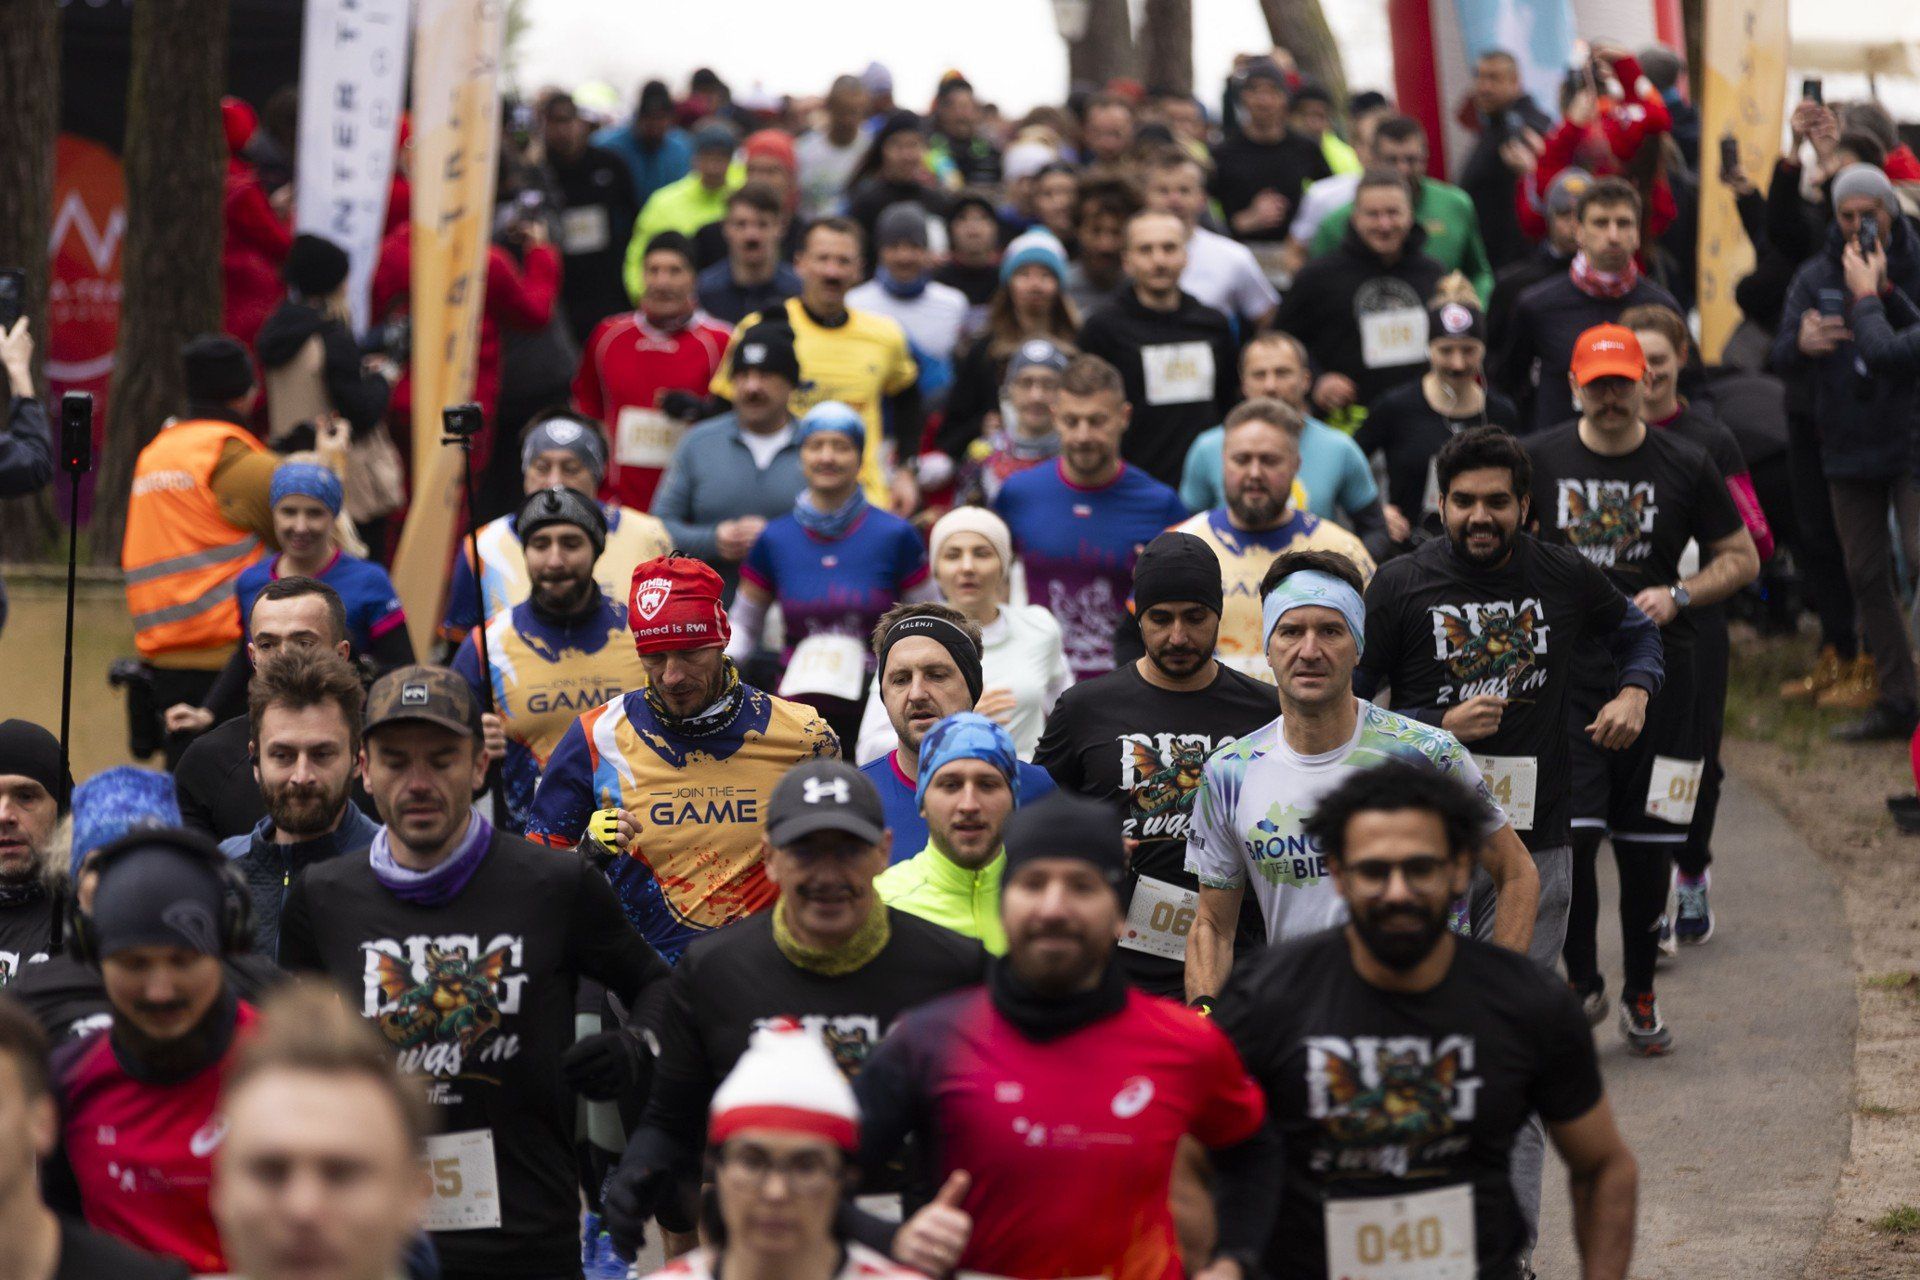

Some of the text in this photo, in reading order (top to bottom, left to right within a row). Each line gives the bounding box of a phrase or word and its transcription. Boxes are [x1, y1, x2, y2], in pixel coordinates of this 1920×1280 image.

[640, 625, 669, 636] need
[673, 624, 682, 633] is
[900, 621, 933, 630] KALENJI
[672, 786, 734, 799] JOIN THE
[650, 800, 757, 825] GAME
[1270, 859, 1290, 874] TEŻ
[1357, 1216, 1442, 1265] 040
